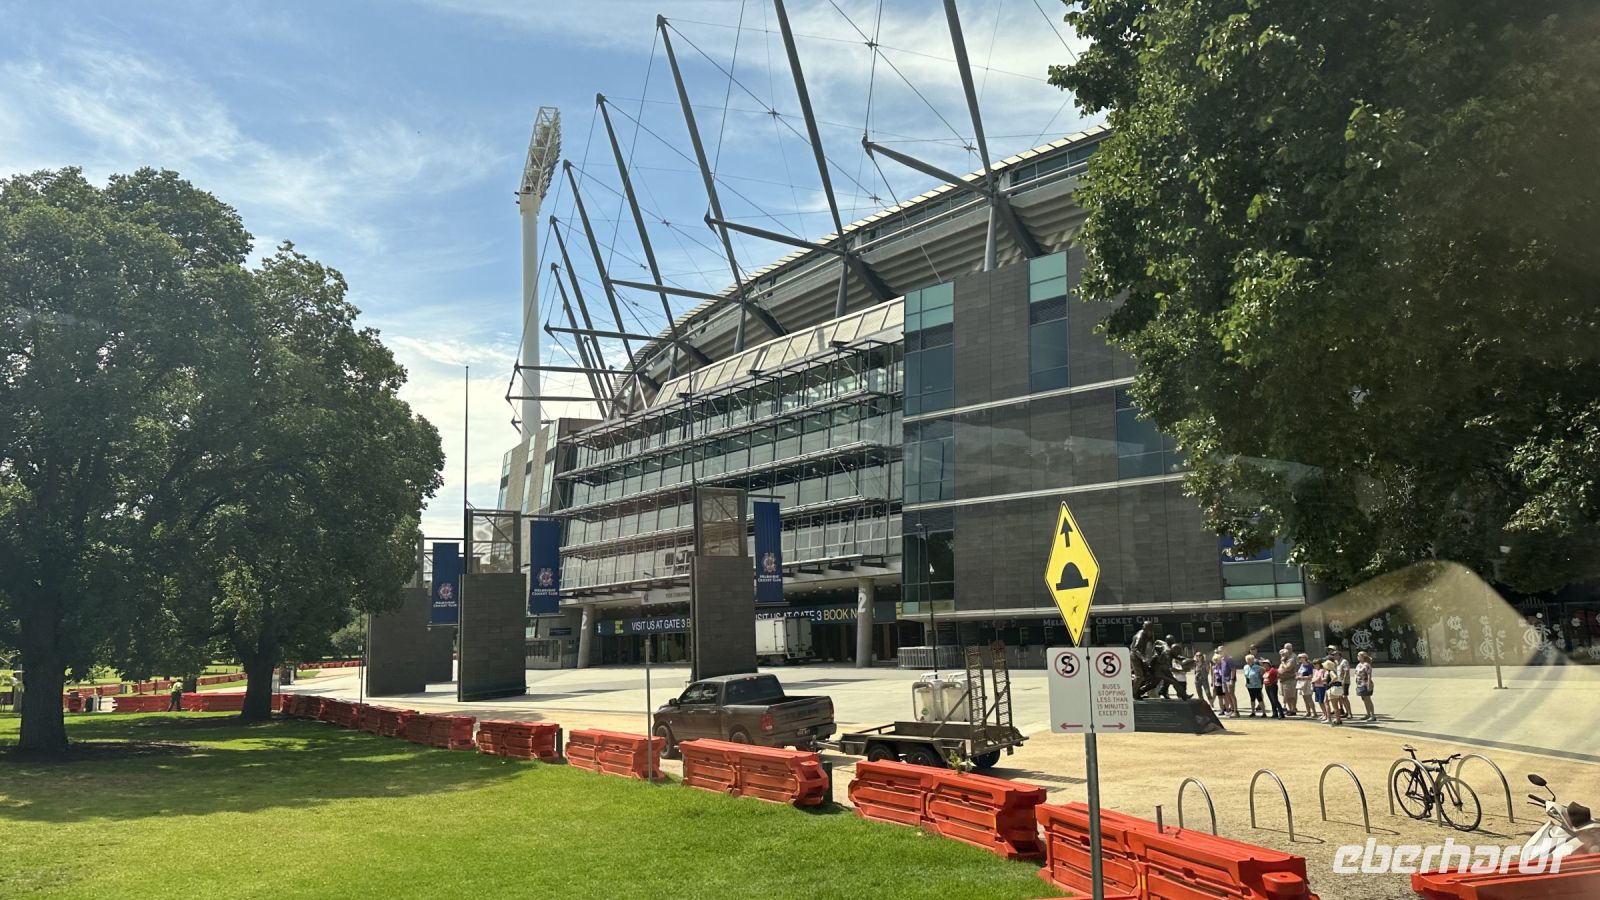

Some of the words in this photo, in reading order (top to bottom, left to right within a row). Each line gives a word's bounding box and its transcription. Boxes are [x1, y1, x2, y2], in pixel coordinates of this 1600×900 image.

[857, 592, 867, 613] 2
[815, 610, 822, 621] 3
[823, 608, 849, 621] BOOK
[631, 621, 646, 631] VISIT
[647, 620, 656, 630] US
[656, 620, 664, 629] AT
[664, 619, 680, 629] GATE
[681, 618, 686, 628] 3
